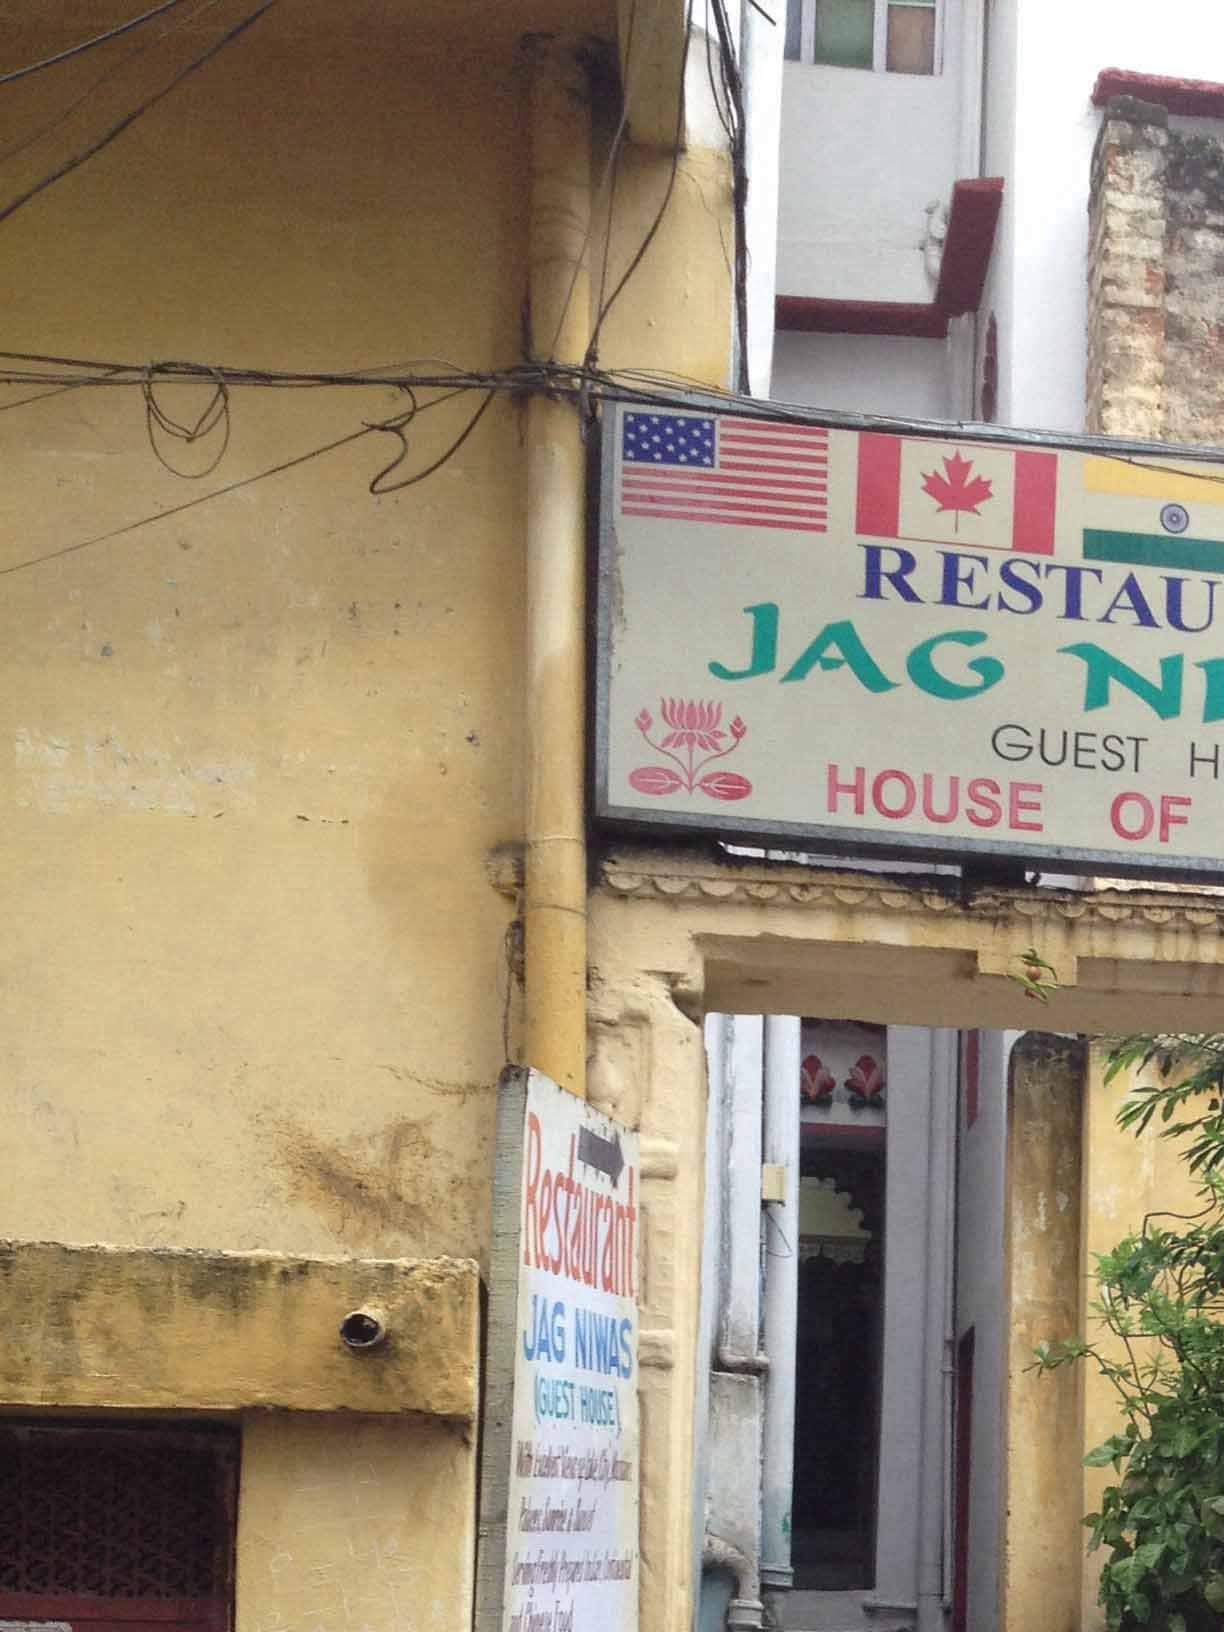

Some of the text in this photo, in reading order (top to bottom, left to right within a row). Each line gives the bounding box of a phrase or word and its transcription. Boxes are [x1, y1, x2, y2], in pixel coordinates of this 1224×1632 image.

[708, 602, 1004, 700] JAG
[991, 724, 1148, 772] GUEST
[826, 764, 1043, 832] HOUSE
[1110, 791, 1192, 841] OF
[524, 1111, 636, 1298] Restaurant
[523, 1294, 633, 1380] JAG NIWAS
[534, 1375, 621, 1431] (GUEST HOUSE)
